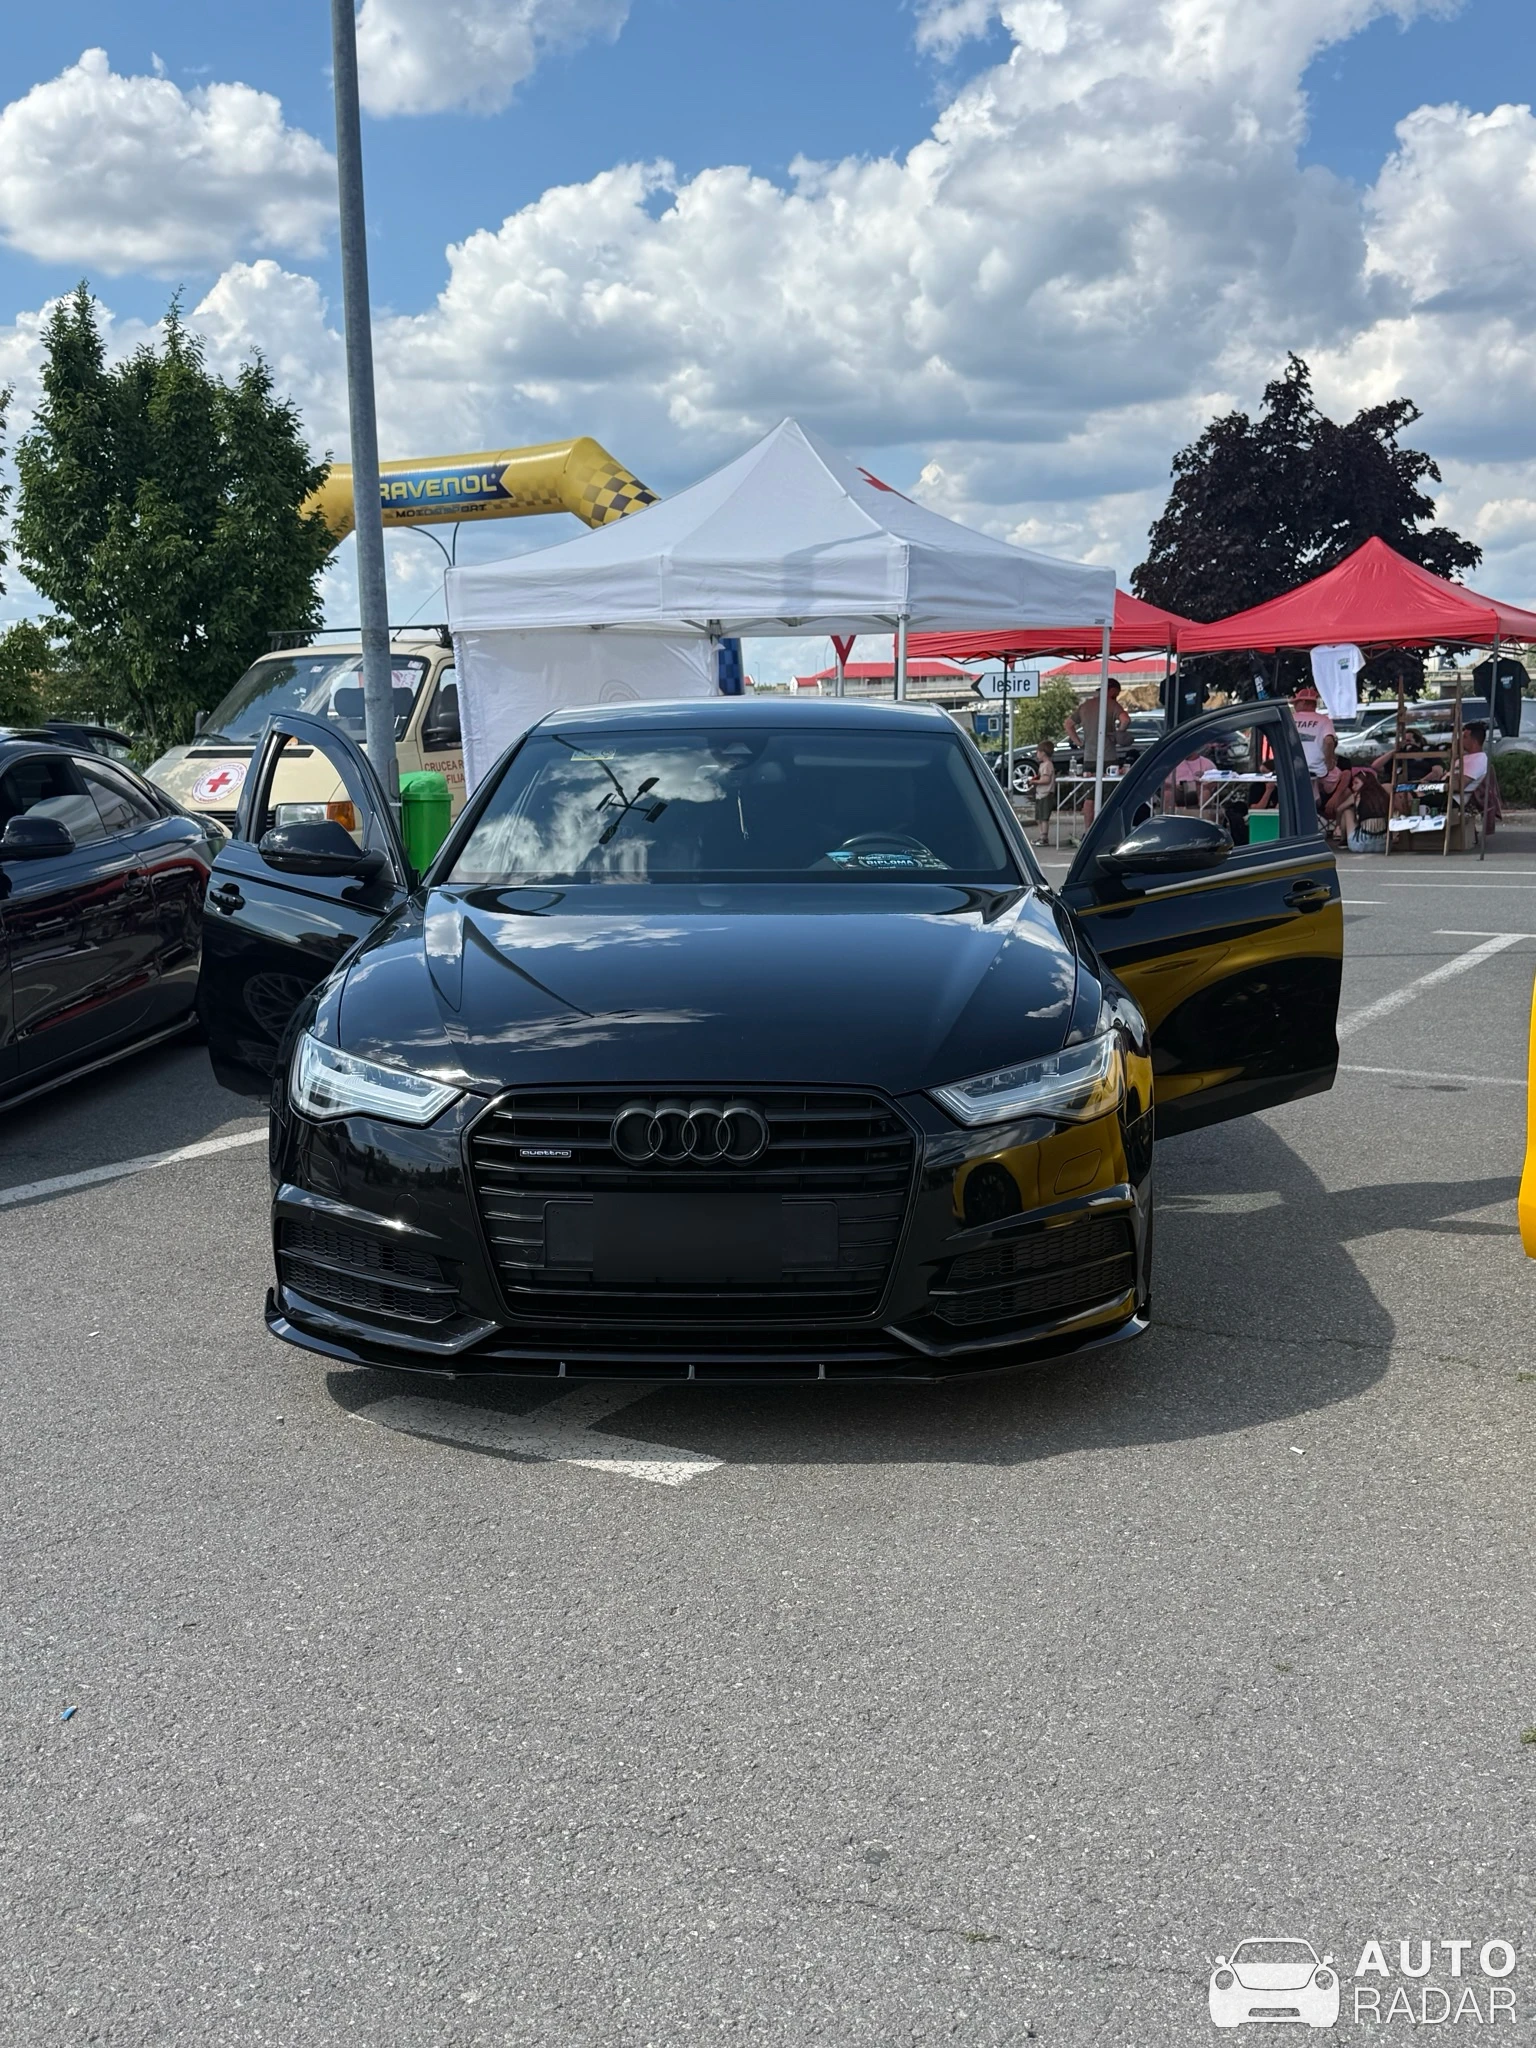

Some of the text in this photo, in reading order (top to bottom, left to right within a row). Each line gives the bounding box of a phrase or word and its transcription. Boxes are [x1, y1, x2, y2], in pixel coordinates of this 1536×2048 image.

[379, 474, 497, 501] RAVENOL
[1294, 720, 1319, 729] TAFF
[424, 760, 457, 772] CRUCEA
[866, 859, 915, 867] DIPLOMA
